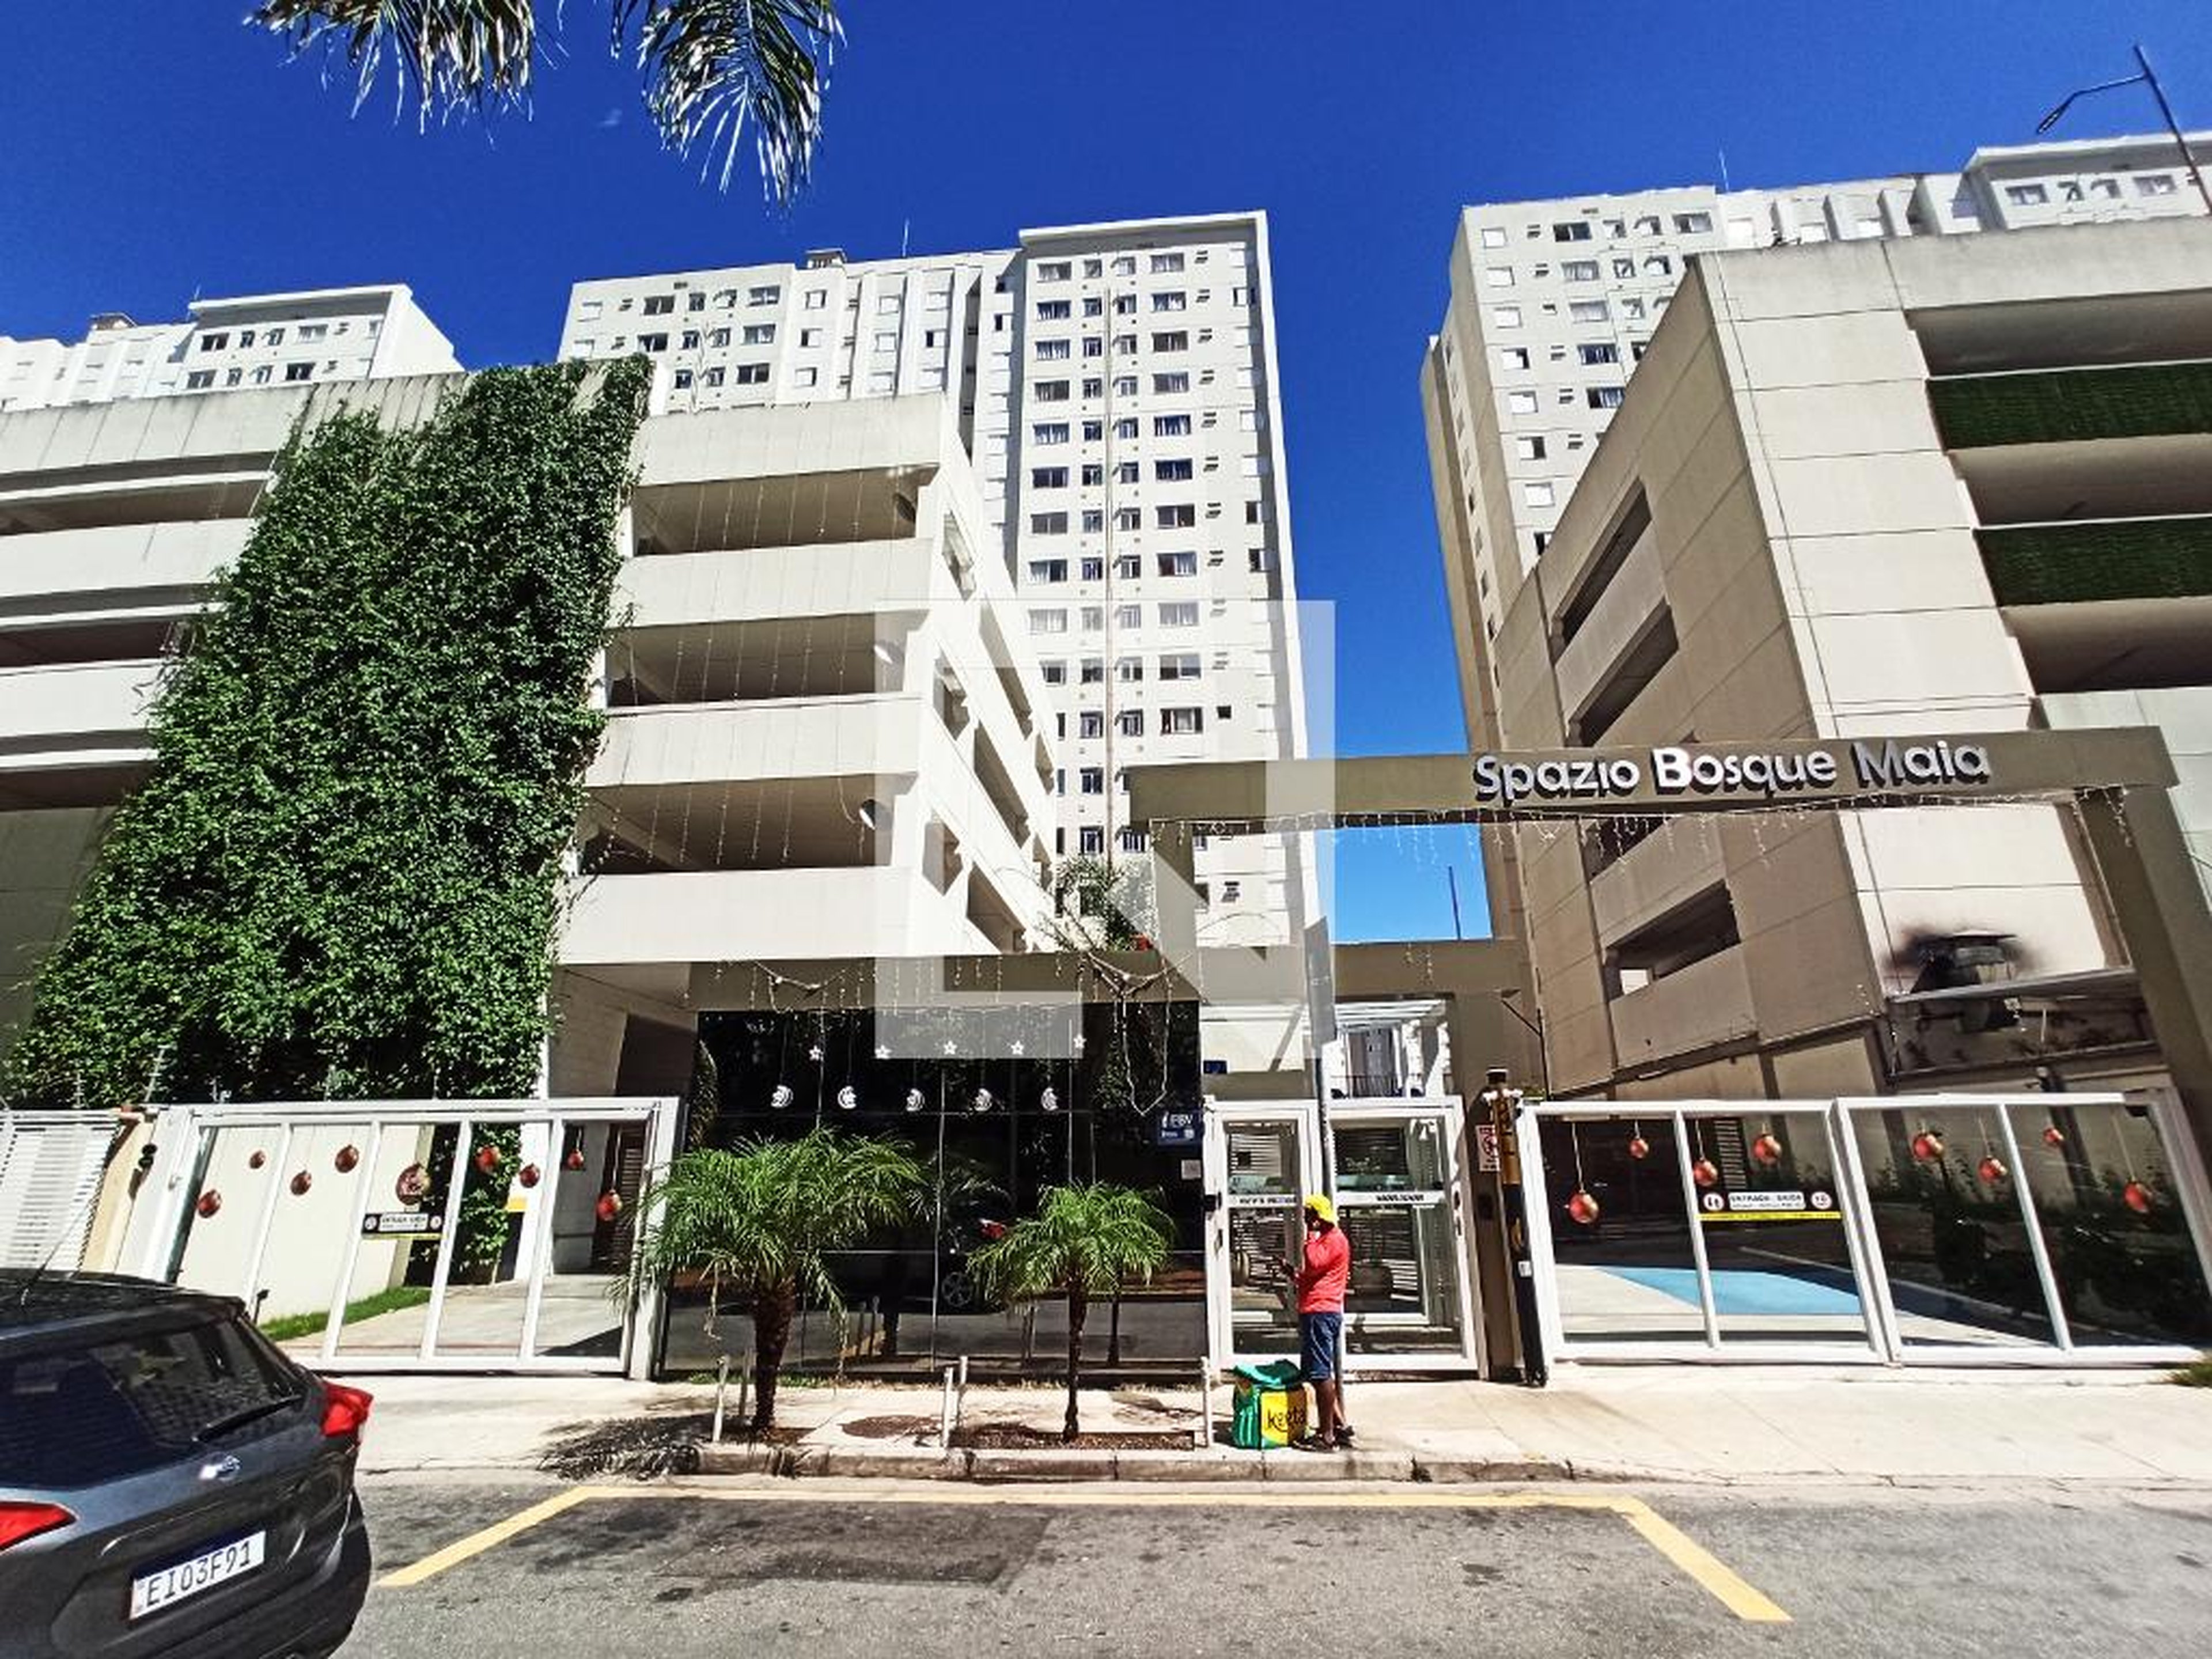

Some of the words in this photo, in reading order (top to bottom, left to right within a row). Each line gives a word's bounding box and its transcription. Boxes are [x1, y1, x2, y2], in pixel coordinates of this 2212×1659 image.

[1474, 755, 1641, 802] Spazio
[1652, 747, 1837, 794] Bosque
[1850, 739, 1991, 786] Maia
